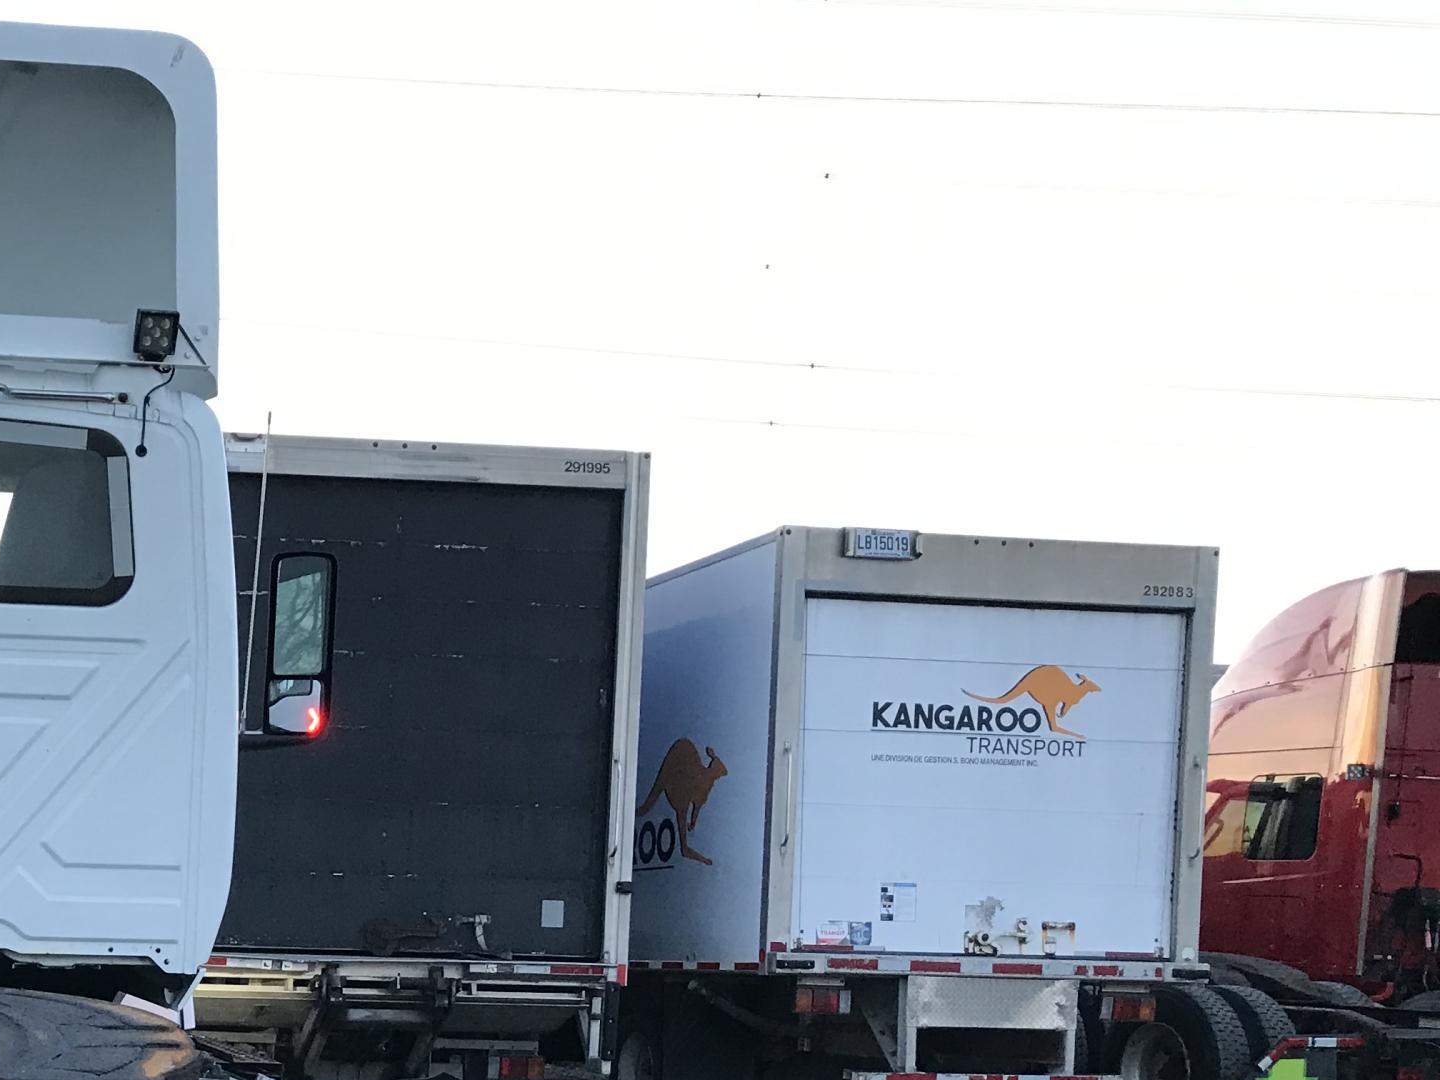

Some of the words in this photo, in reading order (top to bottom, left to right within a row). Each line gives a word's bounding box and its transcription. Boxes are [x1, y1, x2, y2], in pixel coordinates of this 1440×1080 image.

[564, 460, 611, 474] 291995
[1143, 584, 1194, 598] 292083
[871, 701, 1042, 733] KANGAROO
[966, 736, 1087, 757] TRANSPORT
